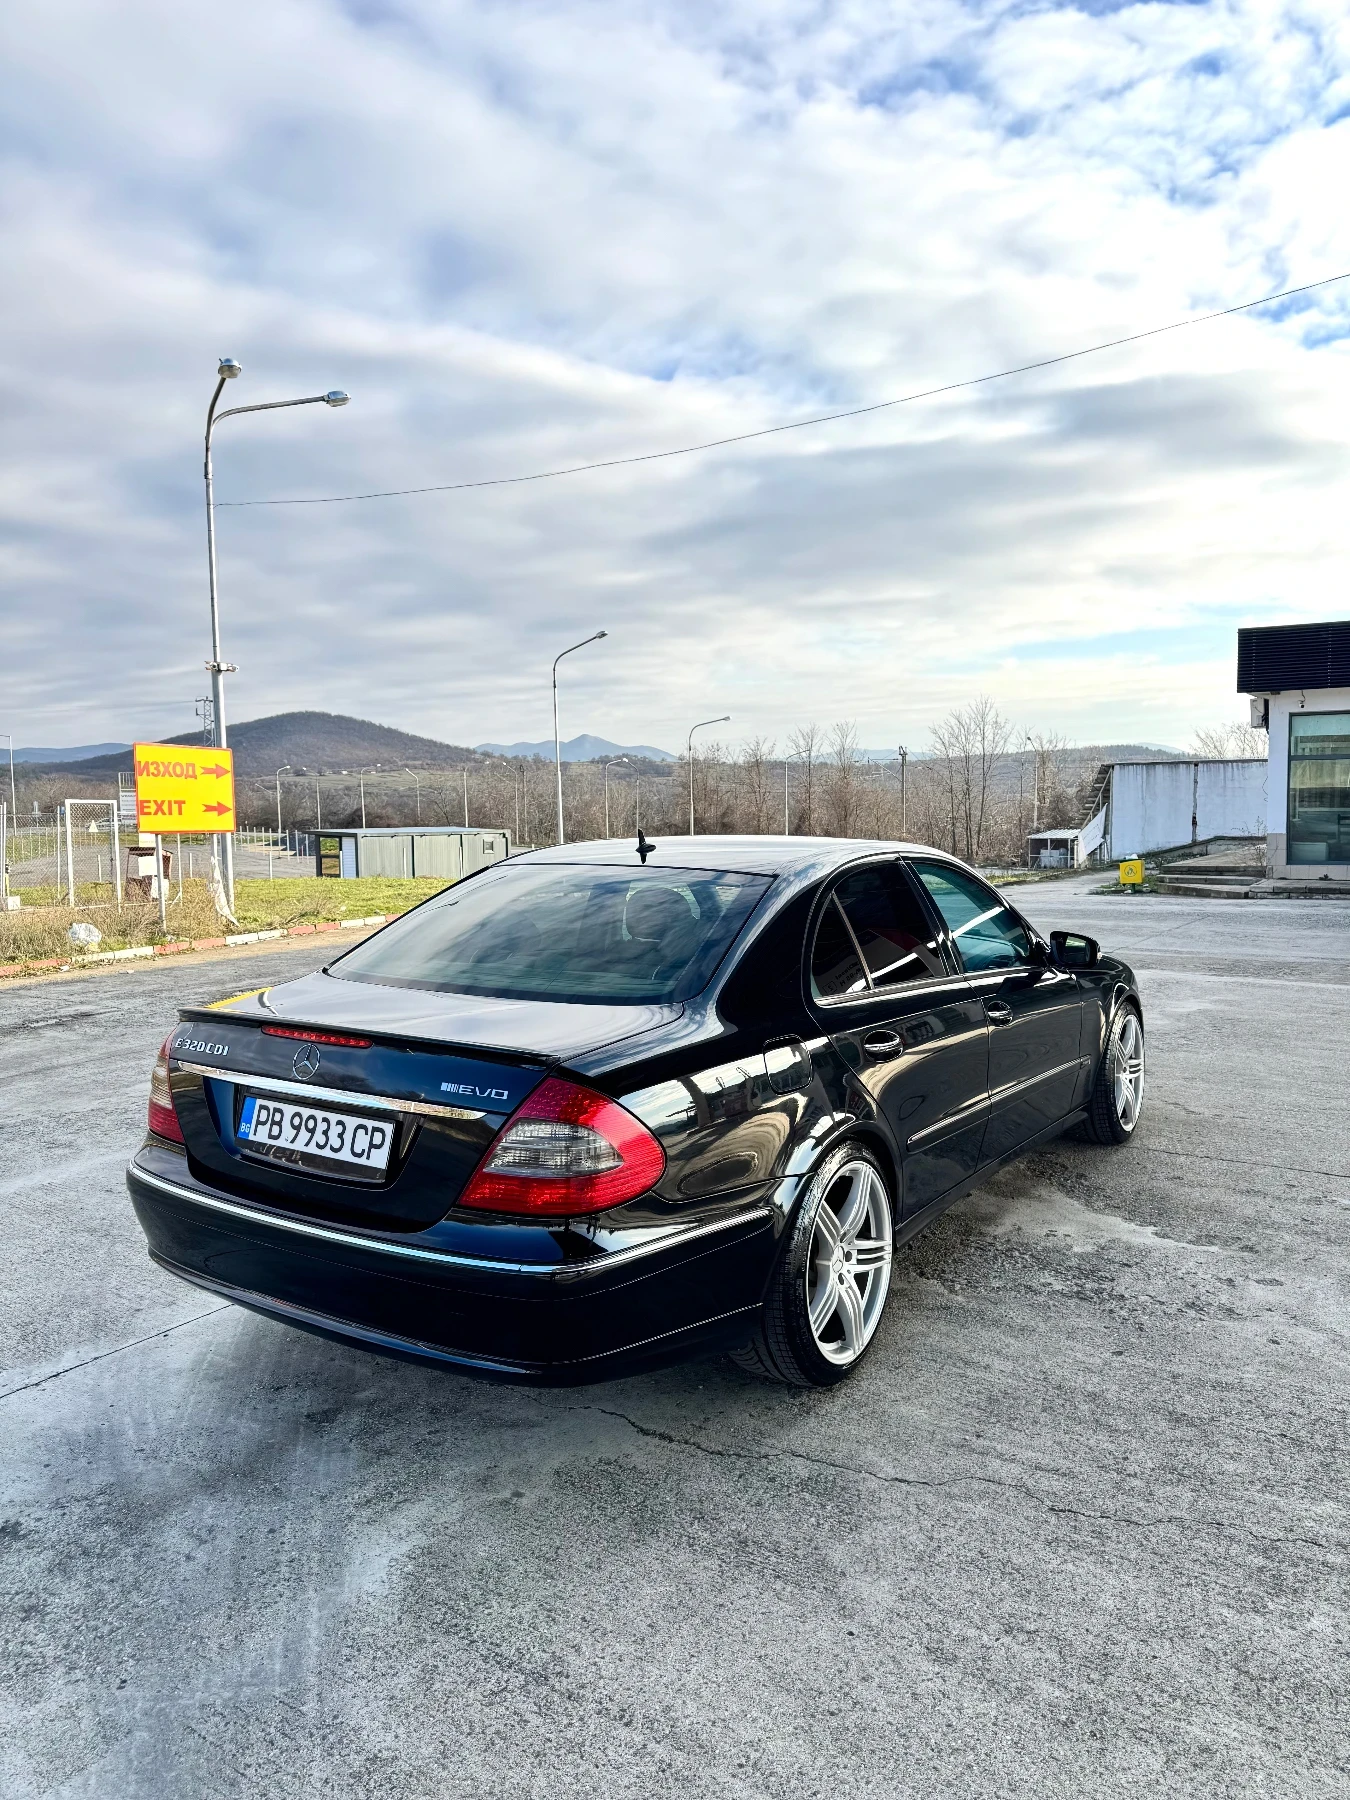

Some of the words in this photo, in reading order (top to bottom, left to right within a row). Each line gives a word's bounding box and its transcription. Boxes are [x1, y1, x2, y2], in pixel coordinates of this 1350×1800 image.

[137, 761, 198, 780] ИЗХОД
[139, 799, 186, 816] EXIT
[459, 1084, 509, 1100] EVO
[240, 1121, 251, 1133] BG
[253, 1103, 285, 1141] PB
[289, 1111, 347, 1154] 9933
[350, 1123, 387, 1161] CP
